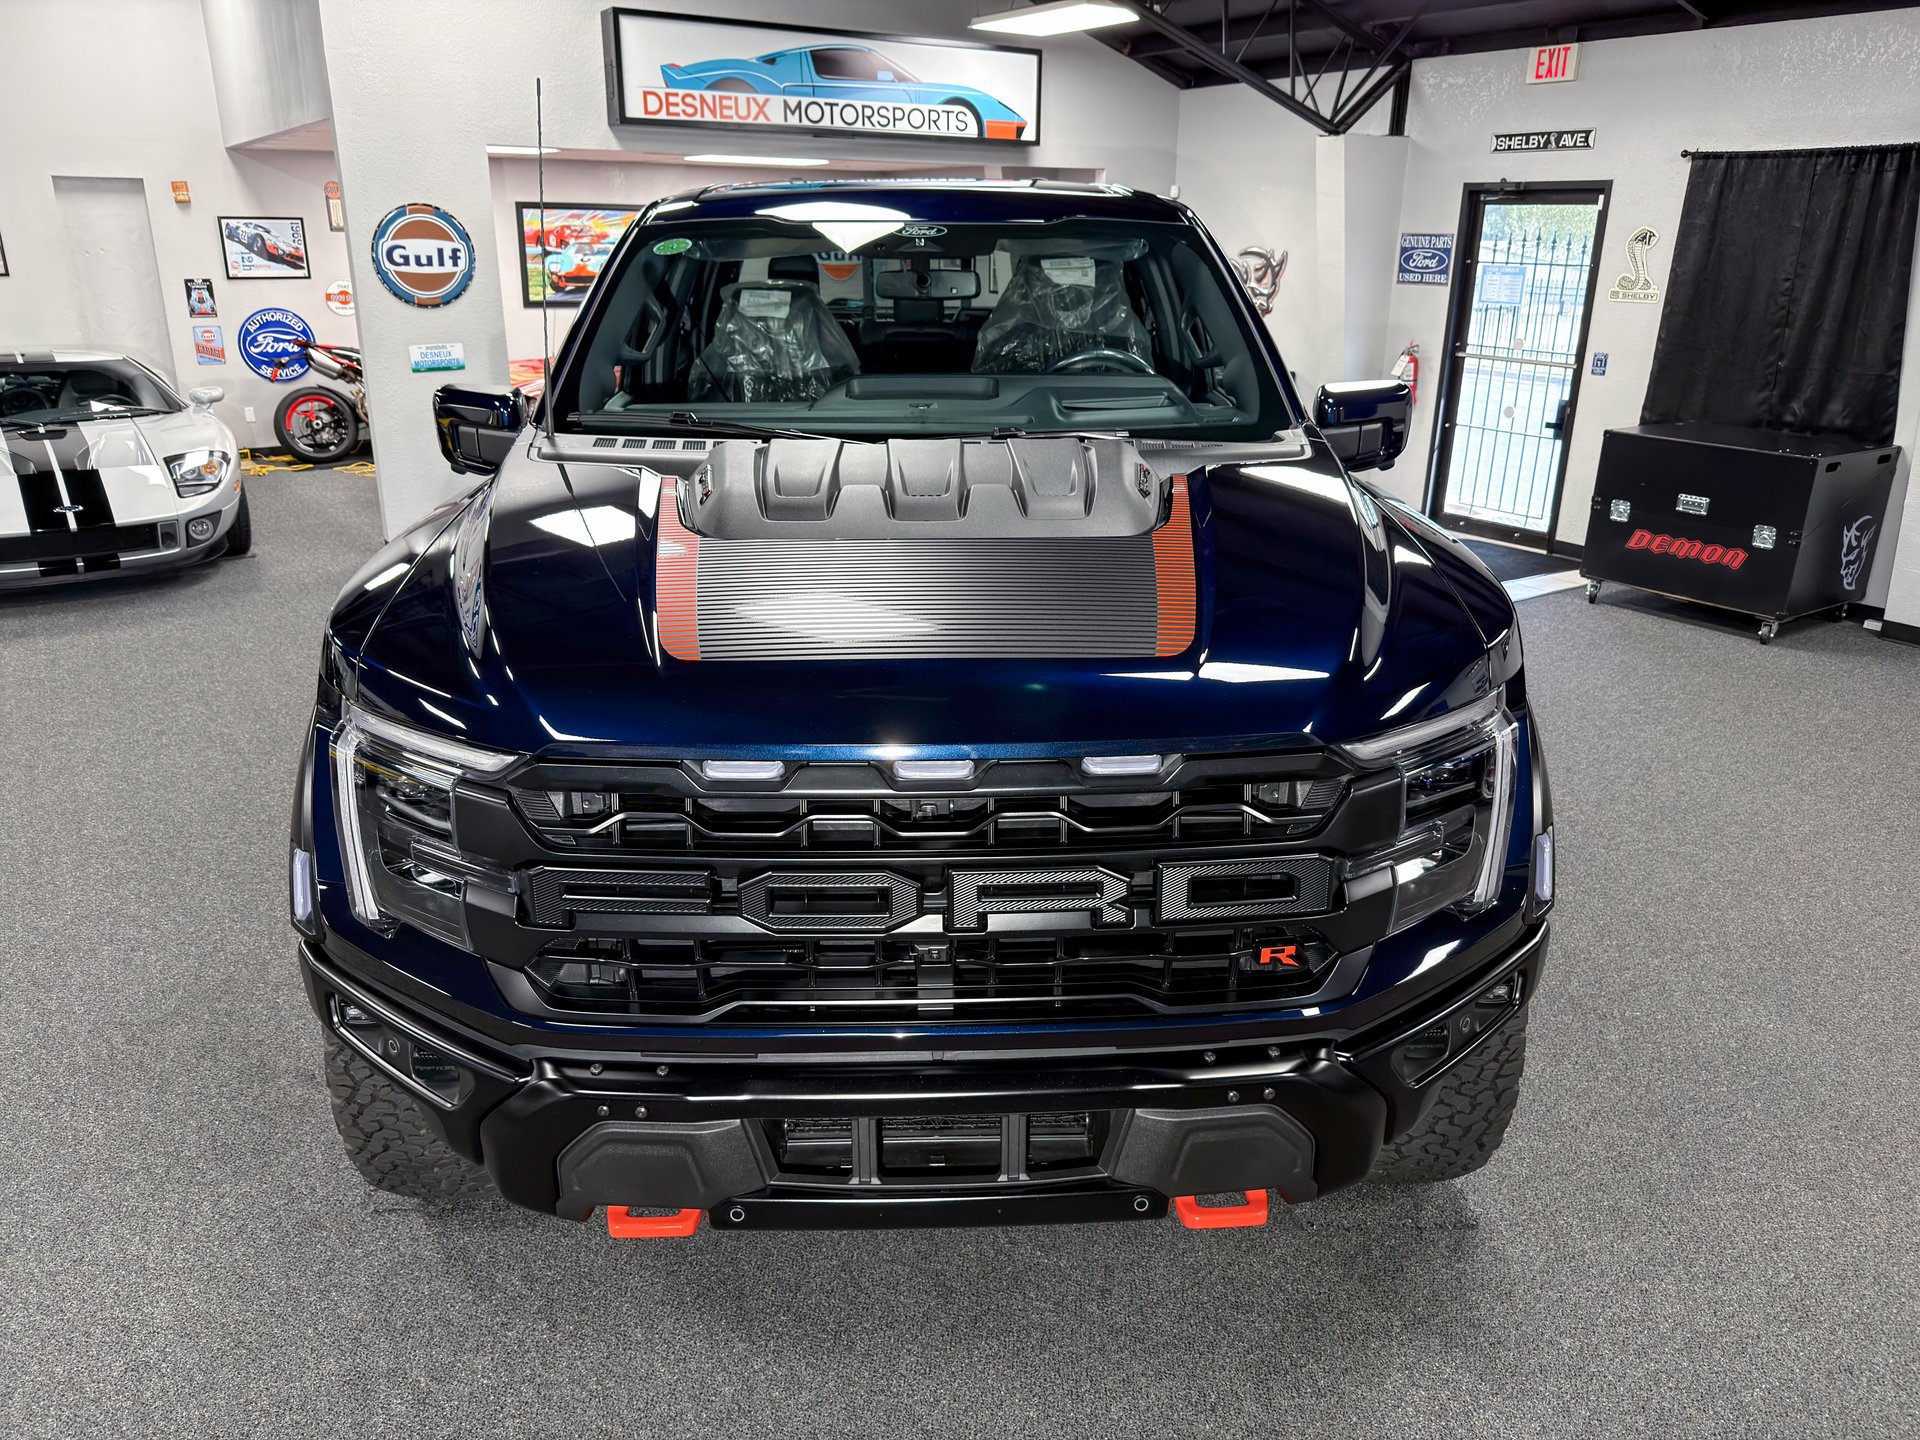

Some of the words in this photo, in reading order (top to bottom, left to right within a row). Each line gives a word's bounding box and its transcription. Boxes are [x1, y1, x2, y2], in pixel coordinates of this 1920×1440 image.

[1535, 46, 1572, 80] EXIT
[642, 90, 771, 123] DESNEUX
[783, 99, 969, 133] MOTORSPORTS
[1496, 134, 1548, 150] SHELBY
[1558, 133, 1588, 148] AVE.
[901, 226, 938, 236] Ford
[1401, 235, 1430, 248] GENUINE
[1430, 236, 1452, 248] PARTS
[385, 244, 462, 268] Gulf
[1408, 251, 1439, 269] Ford
[1399, 272, 1421, 282] USED
[1422, 273, 1447, 283] HERE
[1621, 292, 1657, 300] SHELBY
[246, 312, 304, 333] AUTHORIZED
[414, 358, 460, 367] MOTORSPORTS
[420, 351, 452, 359] DESNEUX
[528, 852, 1334, 936] FORD
[1260, 944, 1300, 967] R
